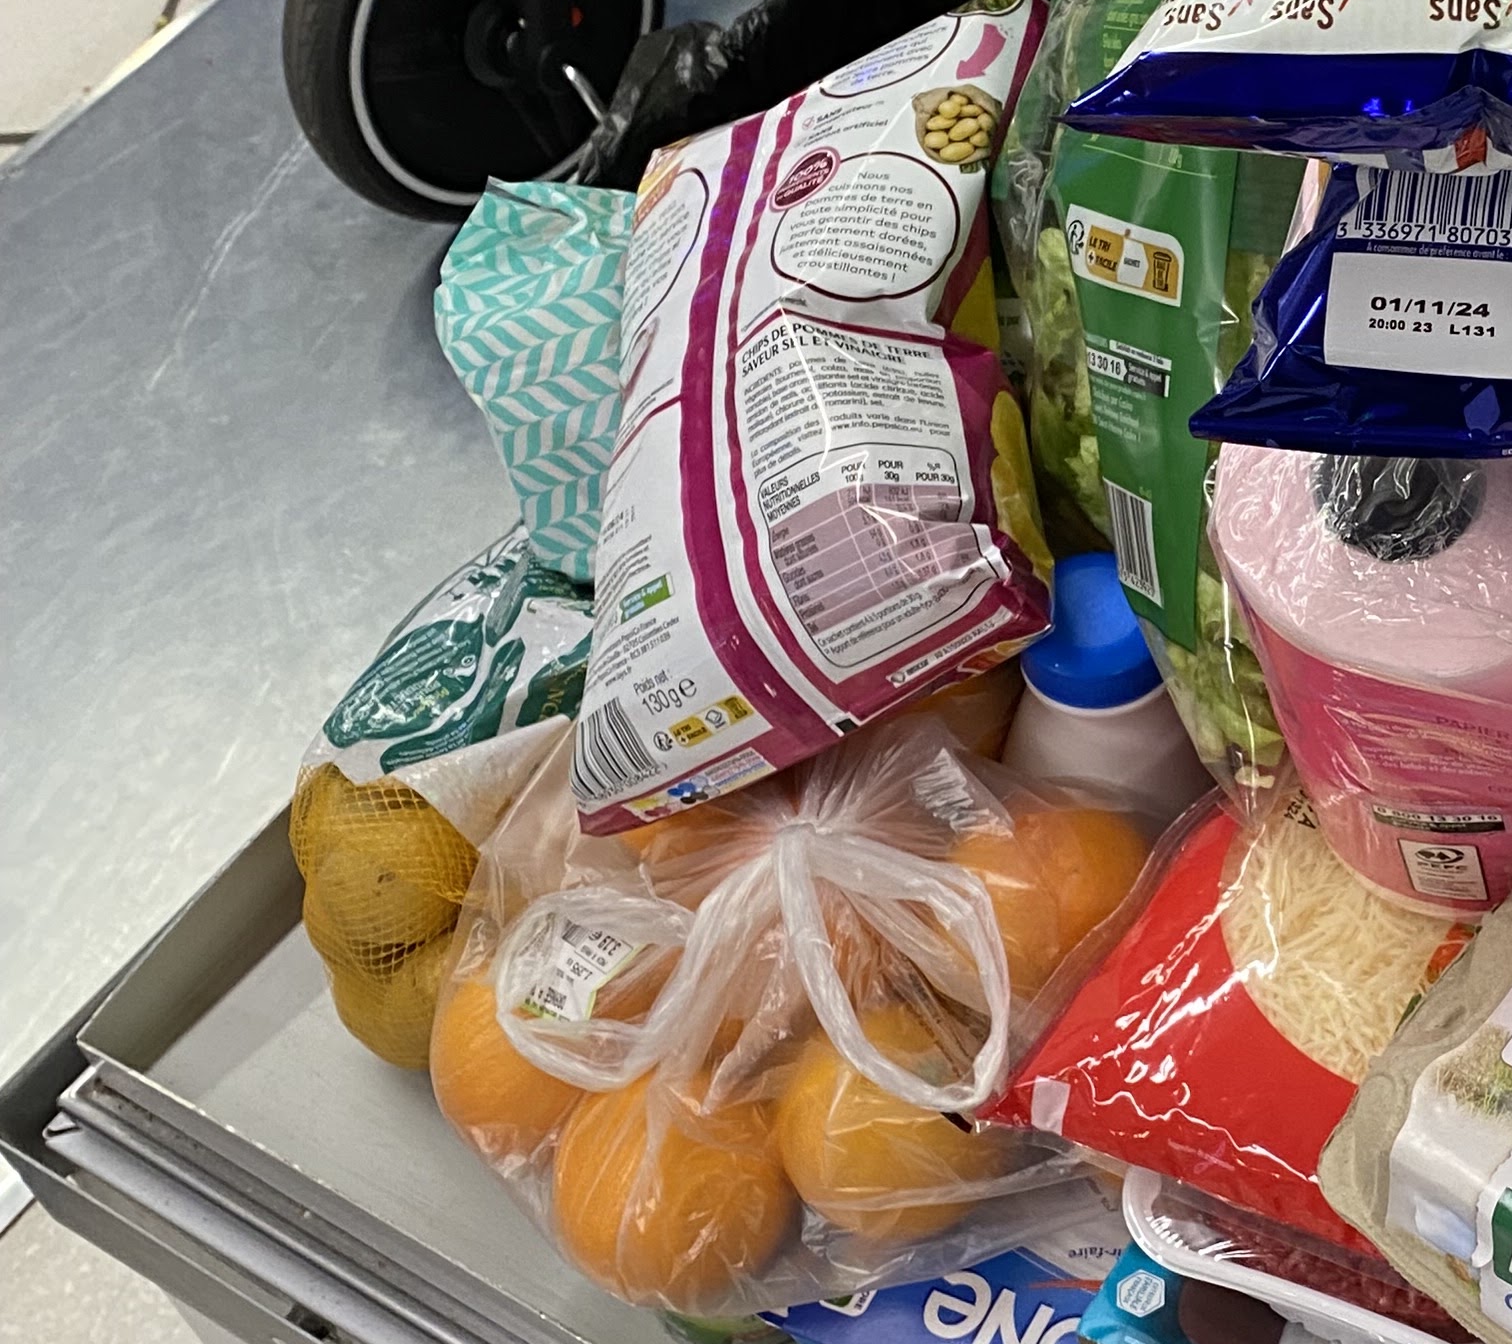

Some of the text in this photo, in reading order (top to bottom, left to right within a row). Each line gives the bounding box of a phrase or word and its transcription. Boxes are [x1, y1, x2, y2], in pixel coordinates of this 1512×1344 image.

[1163, 1, 1223, 32] Sans
[858, 171, 890, 180] Nous
[828, 183, 913, 194] cuisinons nos
[805, 193, 913, 208] pommes de terre
[800, 204, 932, 224] toute simplicité pour
[789, 226, 876, 241] parfaitement
[790, 215, 937, 239] vous garantir des chips
[1363, 222, 1437, 243] 336971
[779, 237, 933, 266] justement assaisonnées
[808, 247, 908, 272] délicieusement
[797, 259, 888, 280] croustillantes
[1370, 296, 1490, 318] 01/11/24
[1369, 318, 1496, 337] 20:00 23 L131
[742, 335, 931, 364] CHIPS TERRE
[742, 345, 780, 377] SAVEUR
[1097, 354, 1121, 375] 30 16
[878, 459, 903, 470] POUR
[885, 471, 900, 482] 30g
[916, 472, 939, 481] POUR
